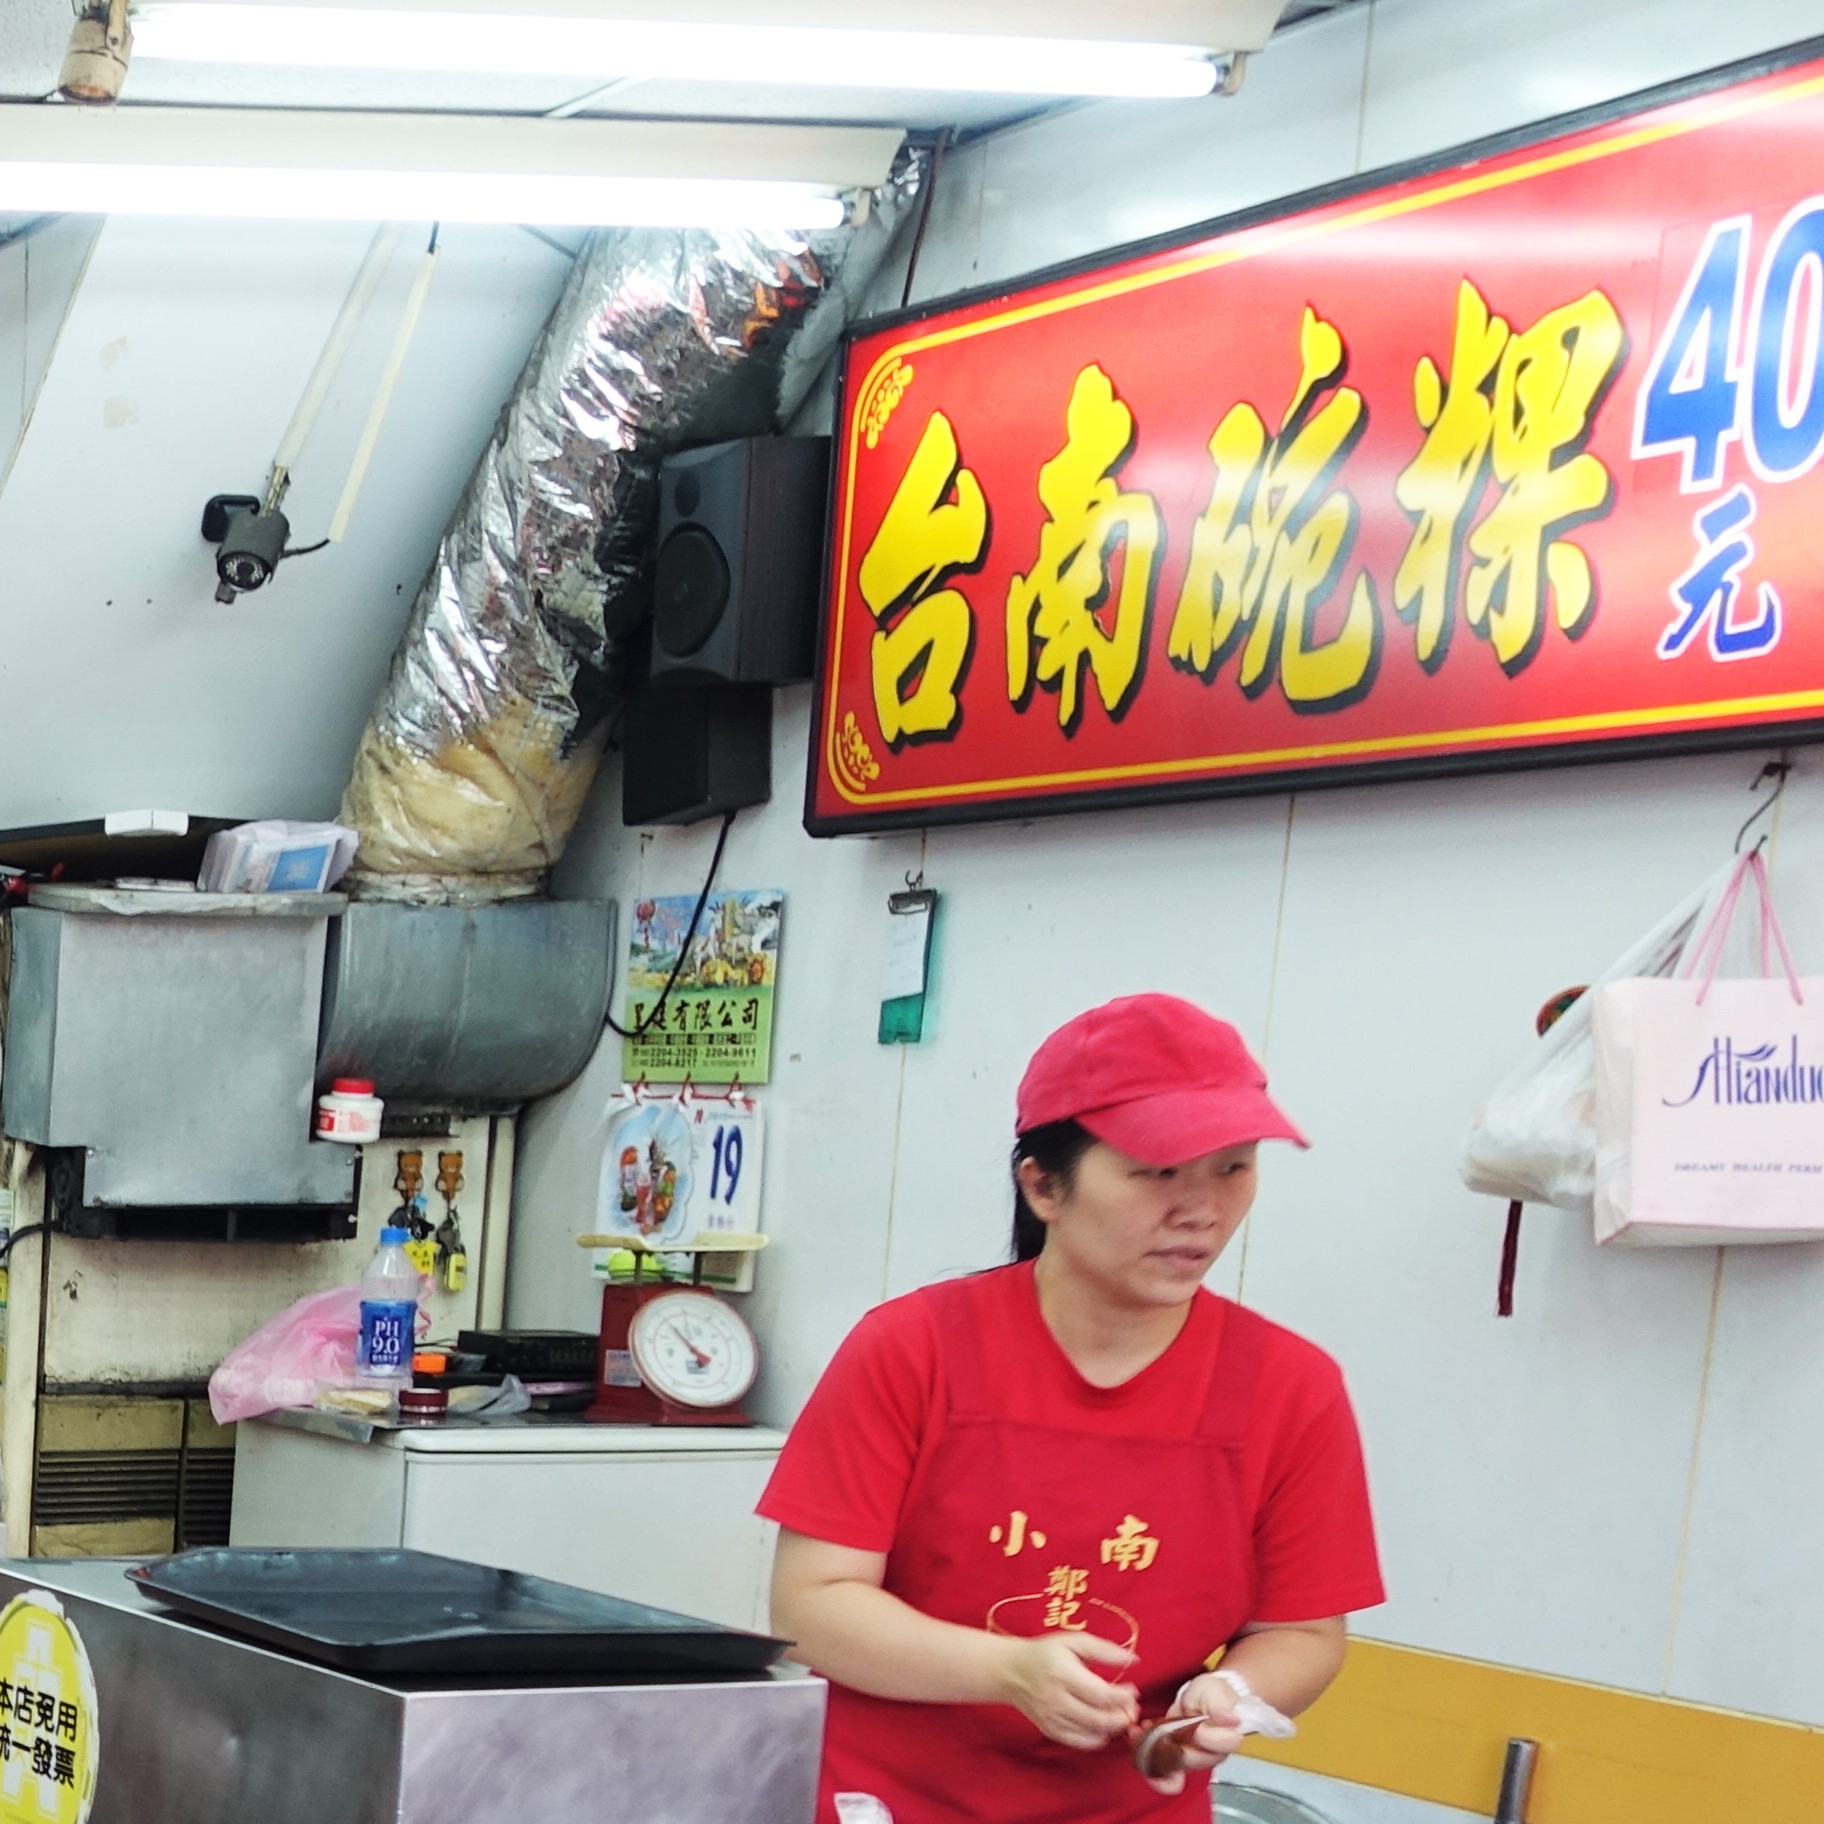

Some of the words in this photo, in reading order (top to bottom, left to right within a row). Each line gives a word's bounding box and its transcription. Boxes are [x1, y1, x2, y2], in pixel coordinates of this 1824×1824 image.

[1632, 196, 1824, 494] 40
[859, 278, 1622, 748] 台南碗粿
[1656, 490, 1780, 662] 元
[710, 1124, 743, 1206] 19
[372, 1336, 400, 1354] 9.0
[375, 1320, 399, 1337] PH
[989, 1510, 1046, 1557] 小
[1100, 1514, 1160, 1571] 南
